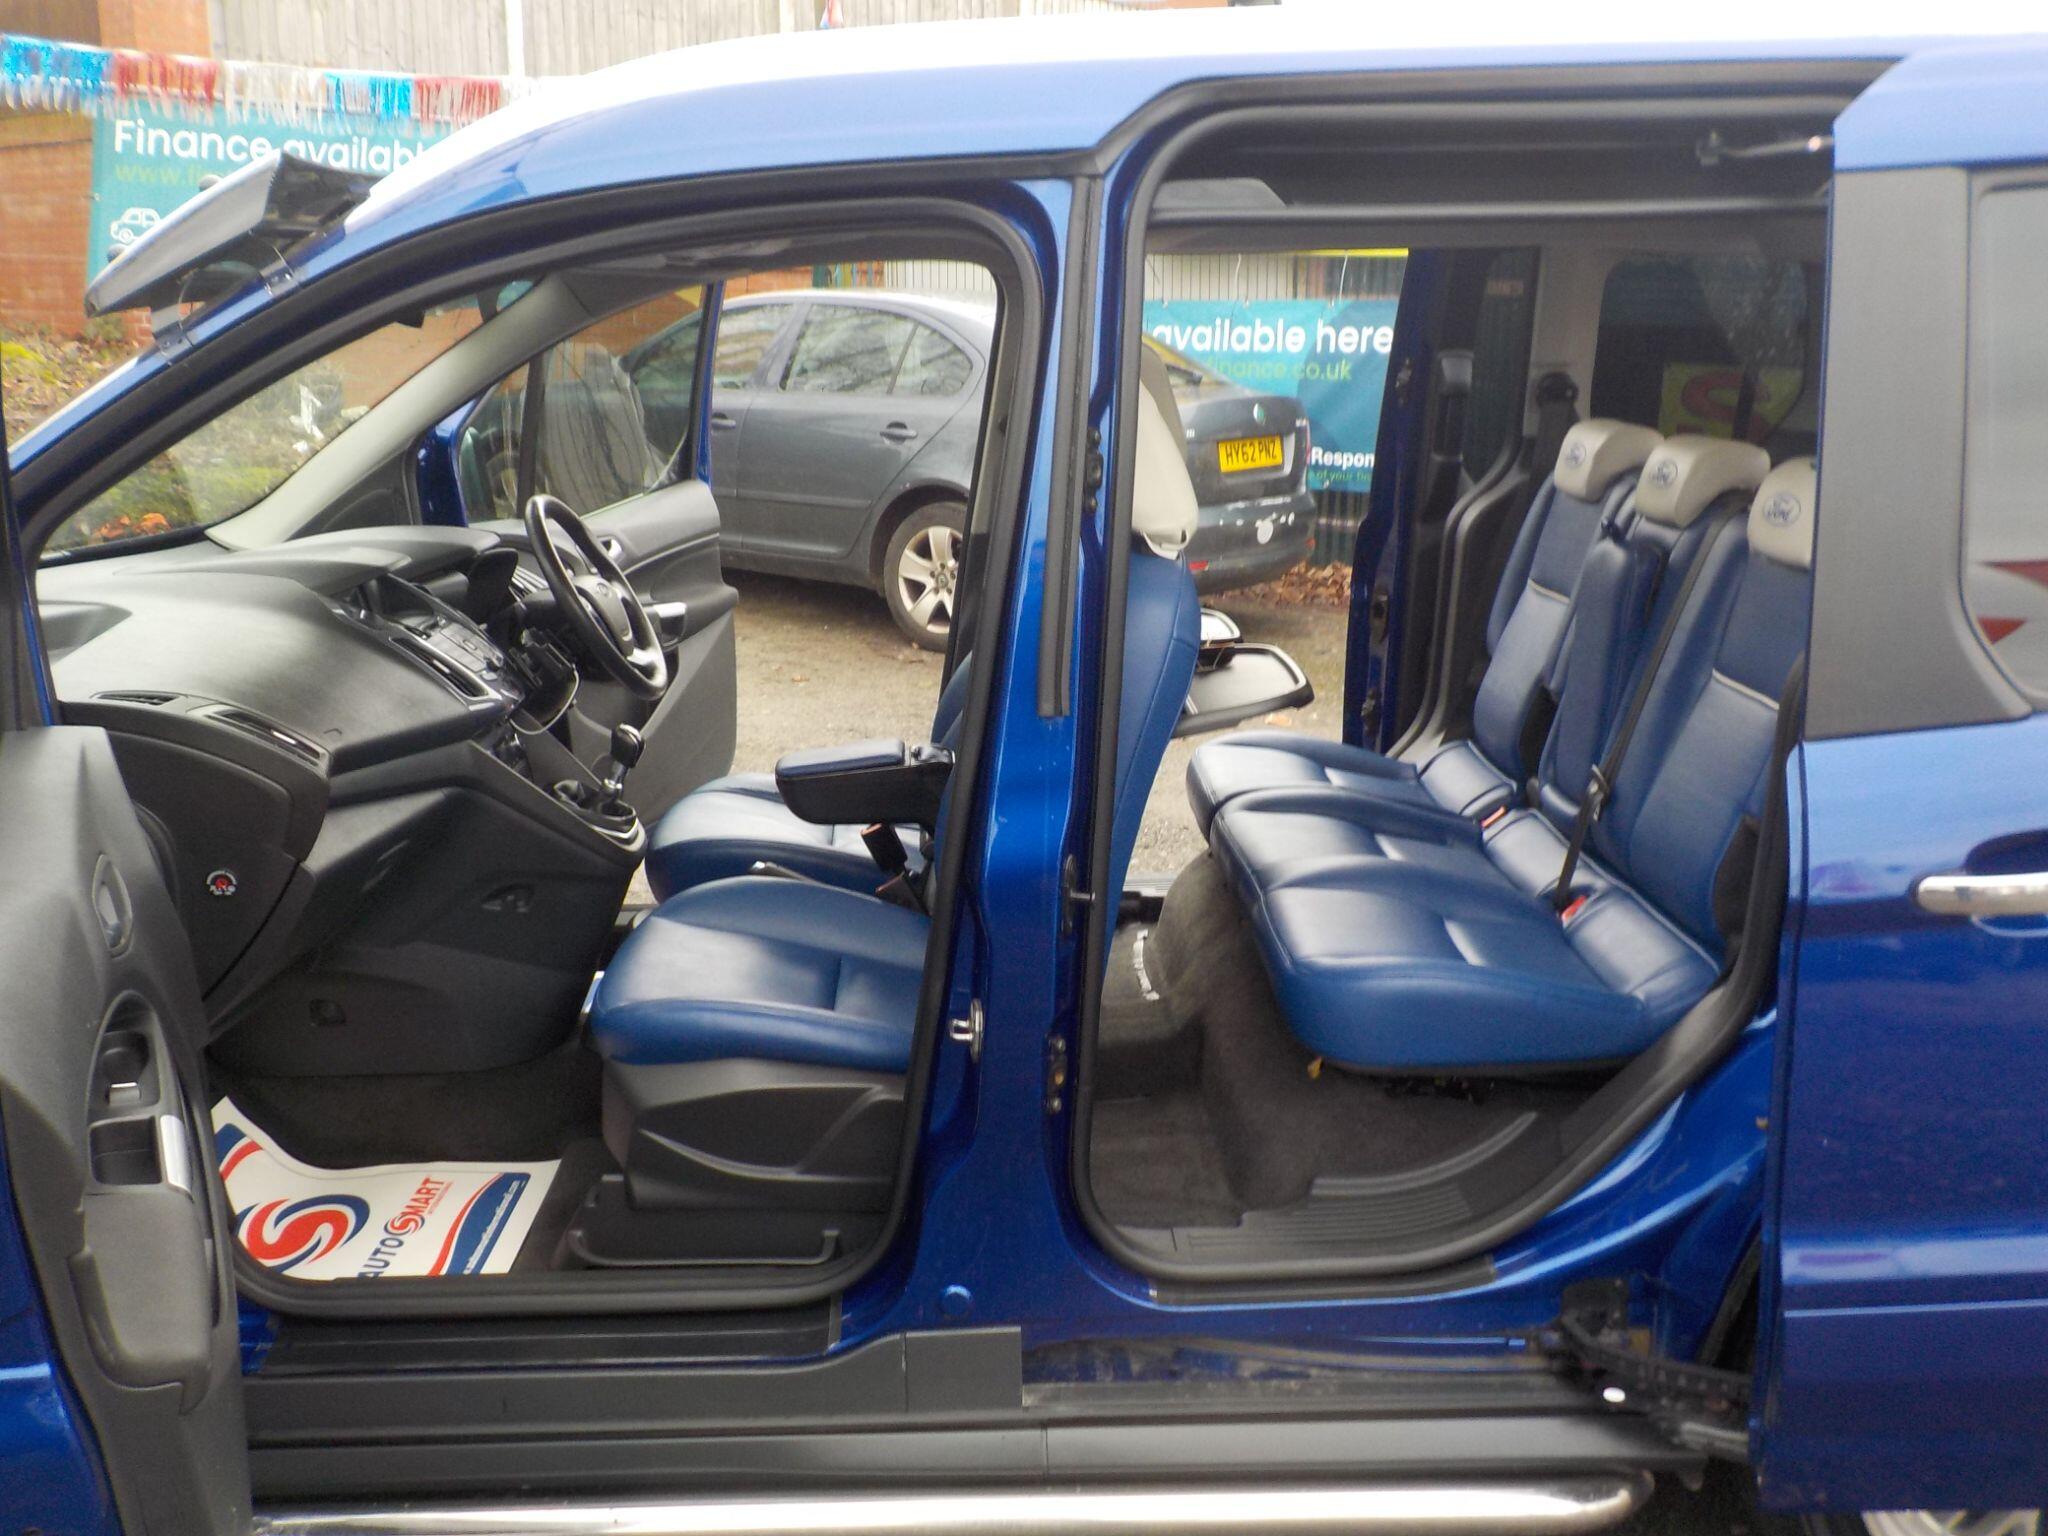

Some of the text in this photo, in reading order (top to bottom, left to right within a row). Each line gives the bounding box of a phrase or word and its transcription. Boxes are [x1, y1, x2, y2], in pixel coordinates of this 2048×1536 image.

[114, 118, 272, 162] Finance
[1152, 317, 1394, 354] available here
[1225, 441, 1256, 466] HY62
